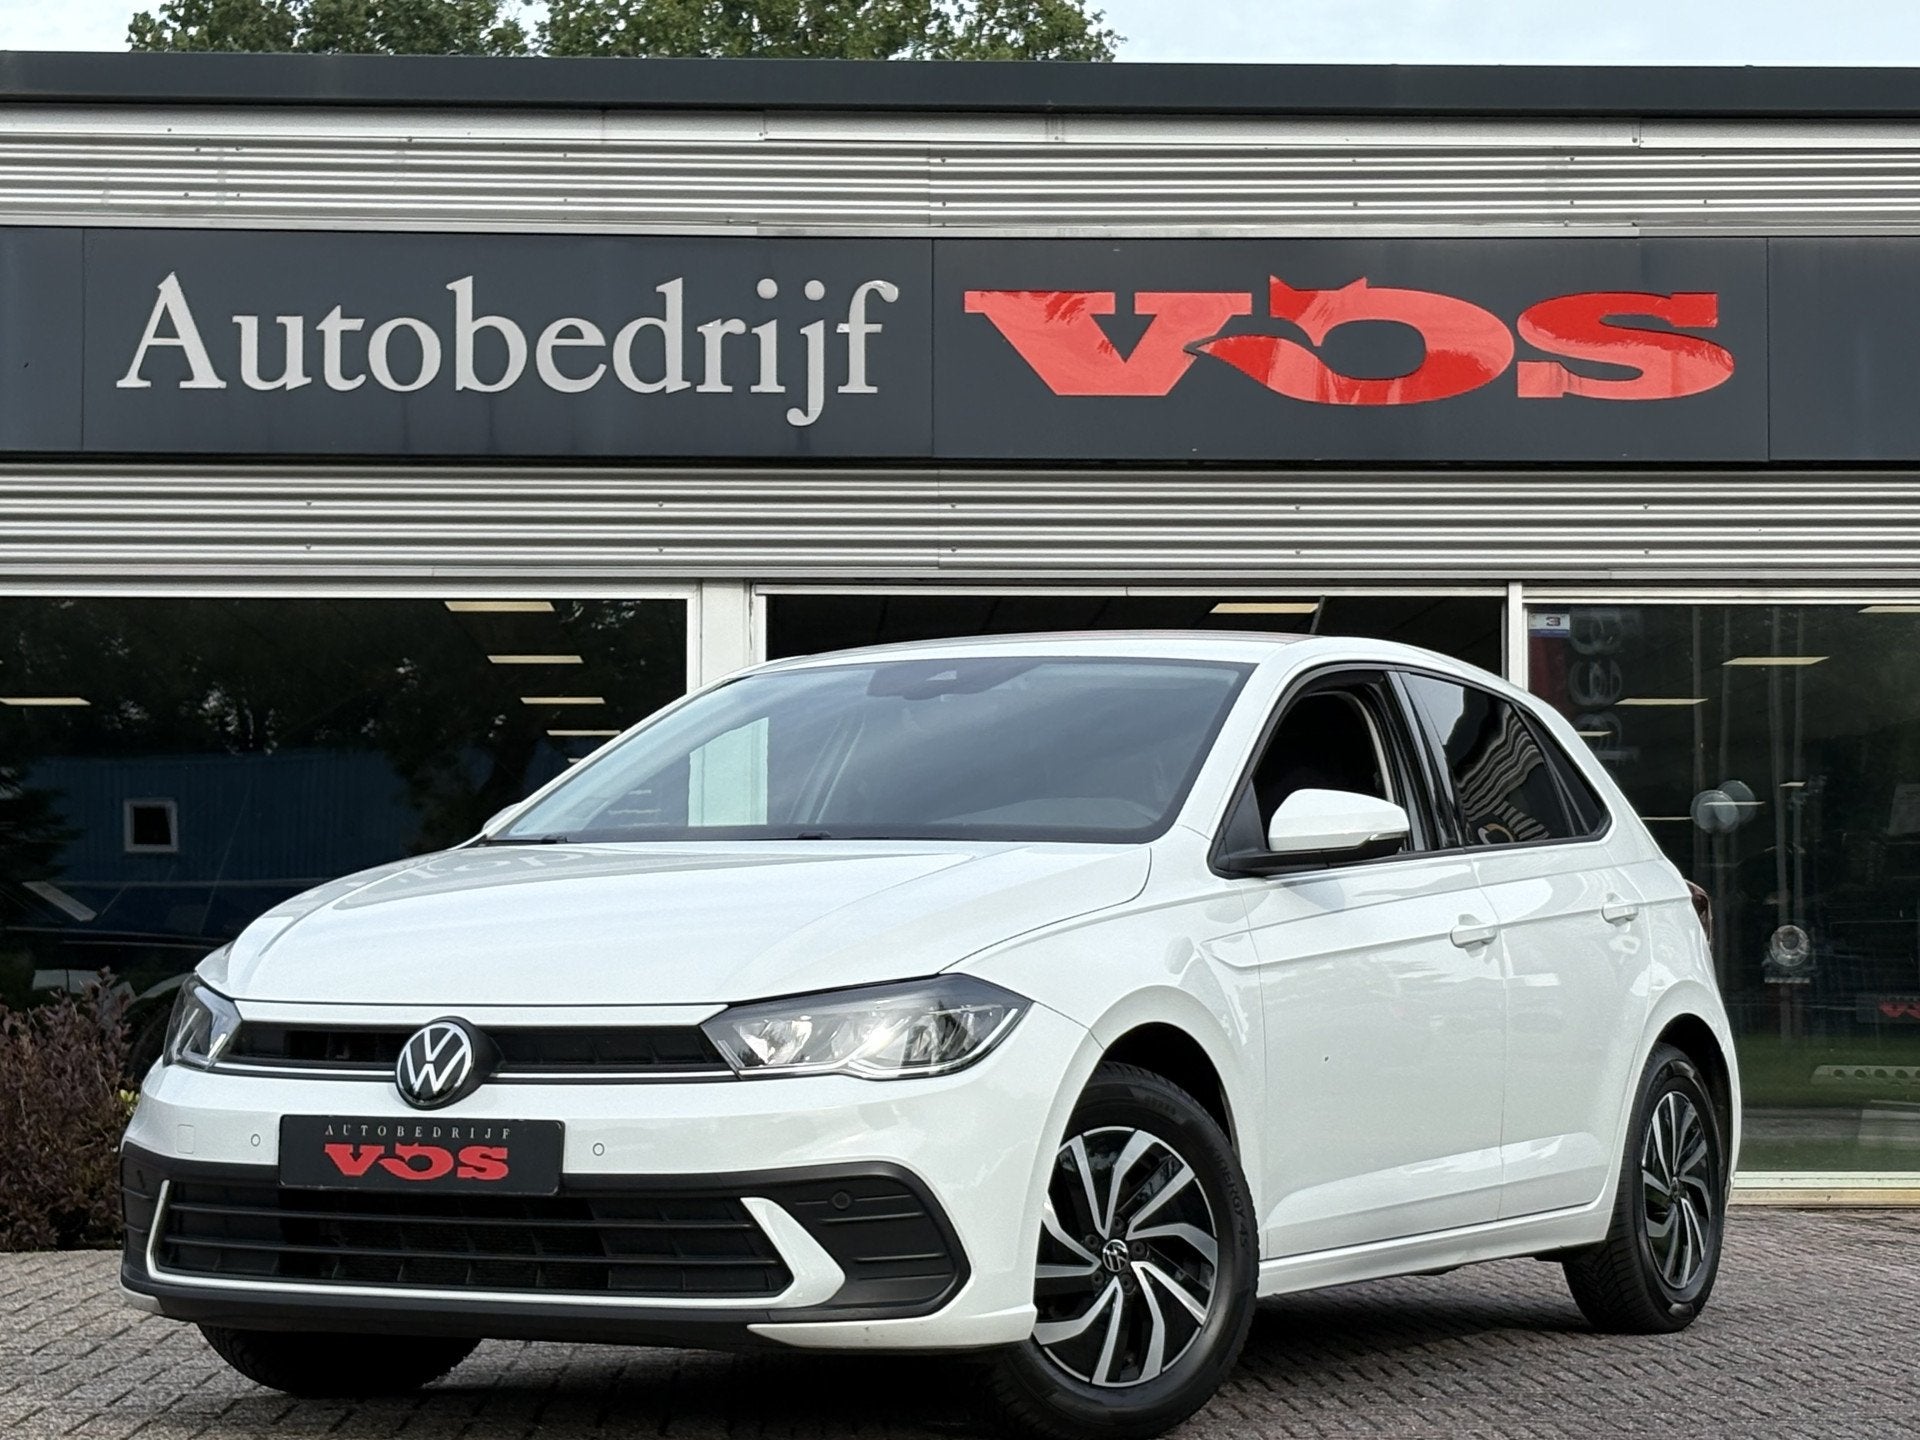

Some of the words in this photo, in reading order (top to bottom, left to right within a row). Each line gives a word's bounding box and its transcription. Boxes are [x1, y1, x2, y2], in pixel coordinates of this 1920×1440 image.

[115, 271, 900, 427] Autobedrijf
[964, 274, 1735, 406] VOS
[396, 1021, 472, 1104] VW
[325, 1124, 511, 1140] AUTOBEDRIJF
[325, 1141, 510, 1181] VOS
